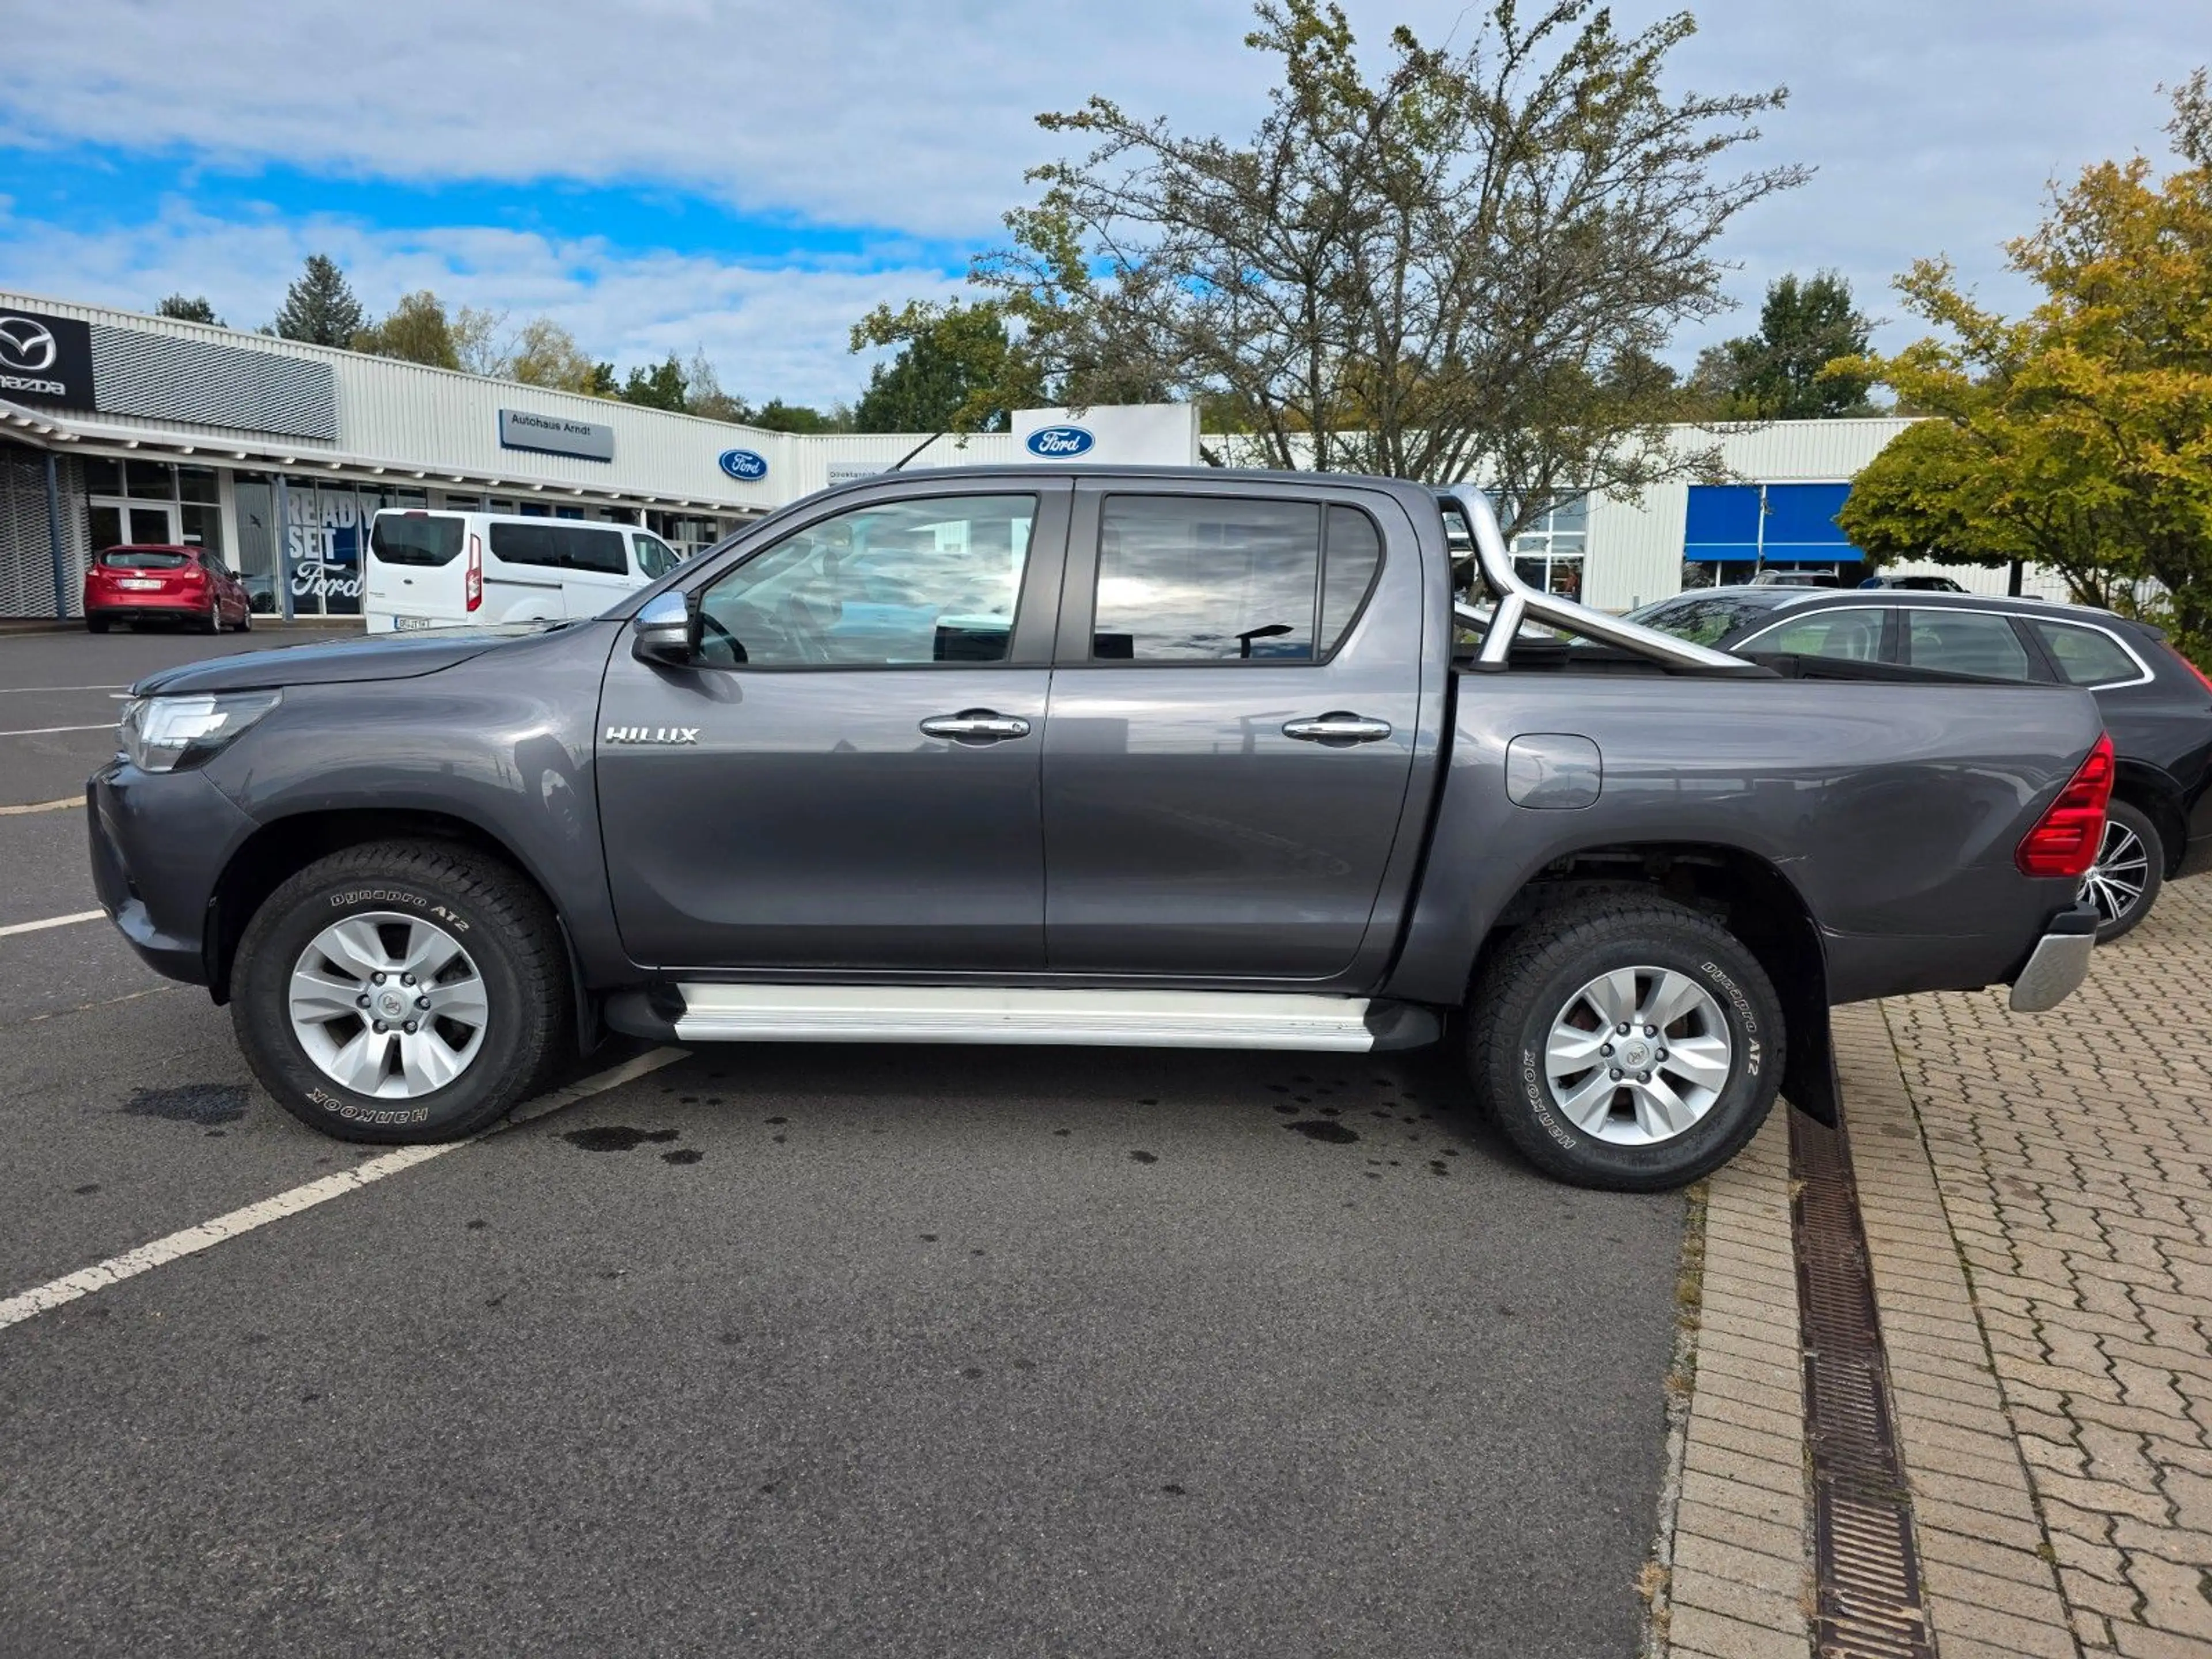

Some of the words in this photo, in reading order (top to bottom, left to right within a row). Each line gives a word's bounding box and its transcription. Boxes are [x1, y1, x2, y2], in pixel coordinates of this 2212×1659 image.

[512, 414, 561, 431] Autohaus
[564, 423, 590, 435] Arndt
[1039, 431, 1081, 452] Ford
[731, 453, 760, 474] Ford
[288, 491, 381, 529] READY
[289, 525, 336, 560] SET
[291, 560, 365, 597] Ford
[605, 726, 701, 744] HILUX
[430, 906, 470, 932] AT2
[1747, 1037, 1761, 1076] AT2
